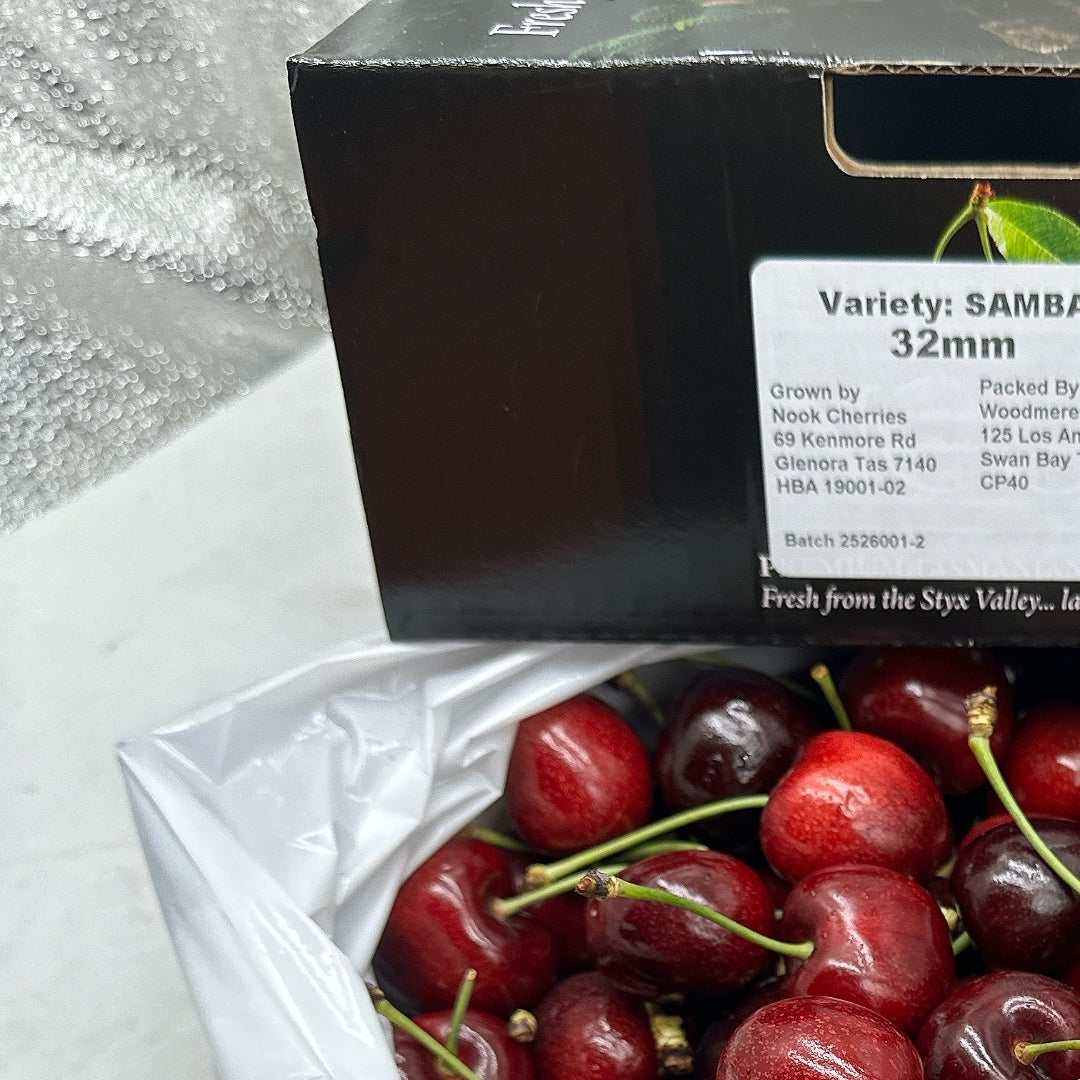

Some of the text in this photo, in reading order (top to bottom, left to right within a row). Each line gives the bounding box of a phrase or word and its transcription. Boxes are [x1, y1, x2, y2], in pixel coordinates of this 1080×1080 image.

[818, 290, 952, 324] Variety:
[891, 328, 1016, 359] 32mm
[770, 383, 860, 403] Grown by
[980, 379, 1080, 399] Packed By
[773, 408, 907, 425] Nook Cherries
[979, 404, 1079, 420] Woodmere
[773, 431, 916, 449] 69 Kenmore Rd
[982, 428, 1012, 444] 125
[1018, 428, 1051, 444] Los
[775, 456, 937, 473] Glenora Tas 7140
[980, 452, 1029, 468] Swan
[1036, 452, 1071, 471] Bay
[777, 479, 906, 496] HBA 19001-02
[980, 475, 1029, 491] CP40
[785, 533, 926, 550] Batch 2526001-2
[761, 584, 819, 610] Fresh
[819, 584, 876, 617] from
[881, 585, 916, 610] the
[920, 586, 970, 617] Styx
[975, 586, 1056, 618] Valley...
